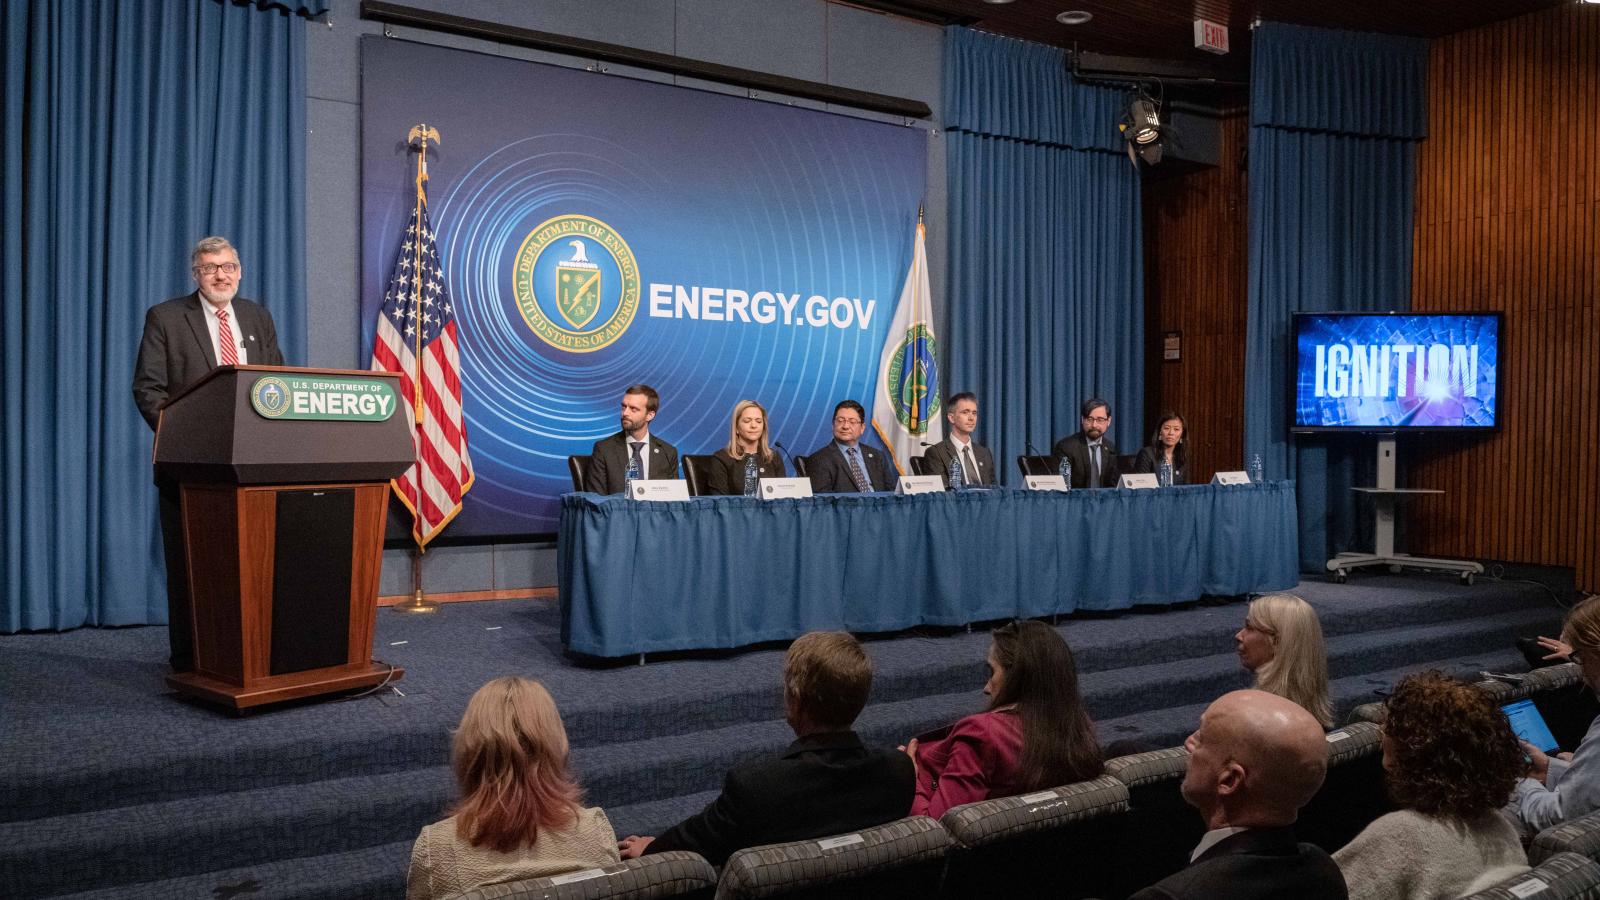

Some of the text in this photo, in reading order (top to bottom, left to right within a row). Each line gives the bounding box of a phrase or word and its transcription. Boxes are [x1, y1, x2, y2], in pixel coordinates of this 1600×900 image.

[1205, 23, 1225, 48] EXIT
[520, 221, 635, 282] DEPARTMENT OF ENERGY
[518, 279, 636, 347] UNITED STATES OF AMERICA
[649, 283, 876, 330] ENERGY.GOV
[292, 381, 310, 389] U.S.
[313, 382, 369, 391] DEPARTMENT
[1315, 344, 1479, 398] IGNITION
[293, 391, 392, 415] ENERGY
